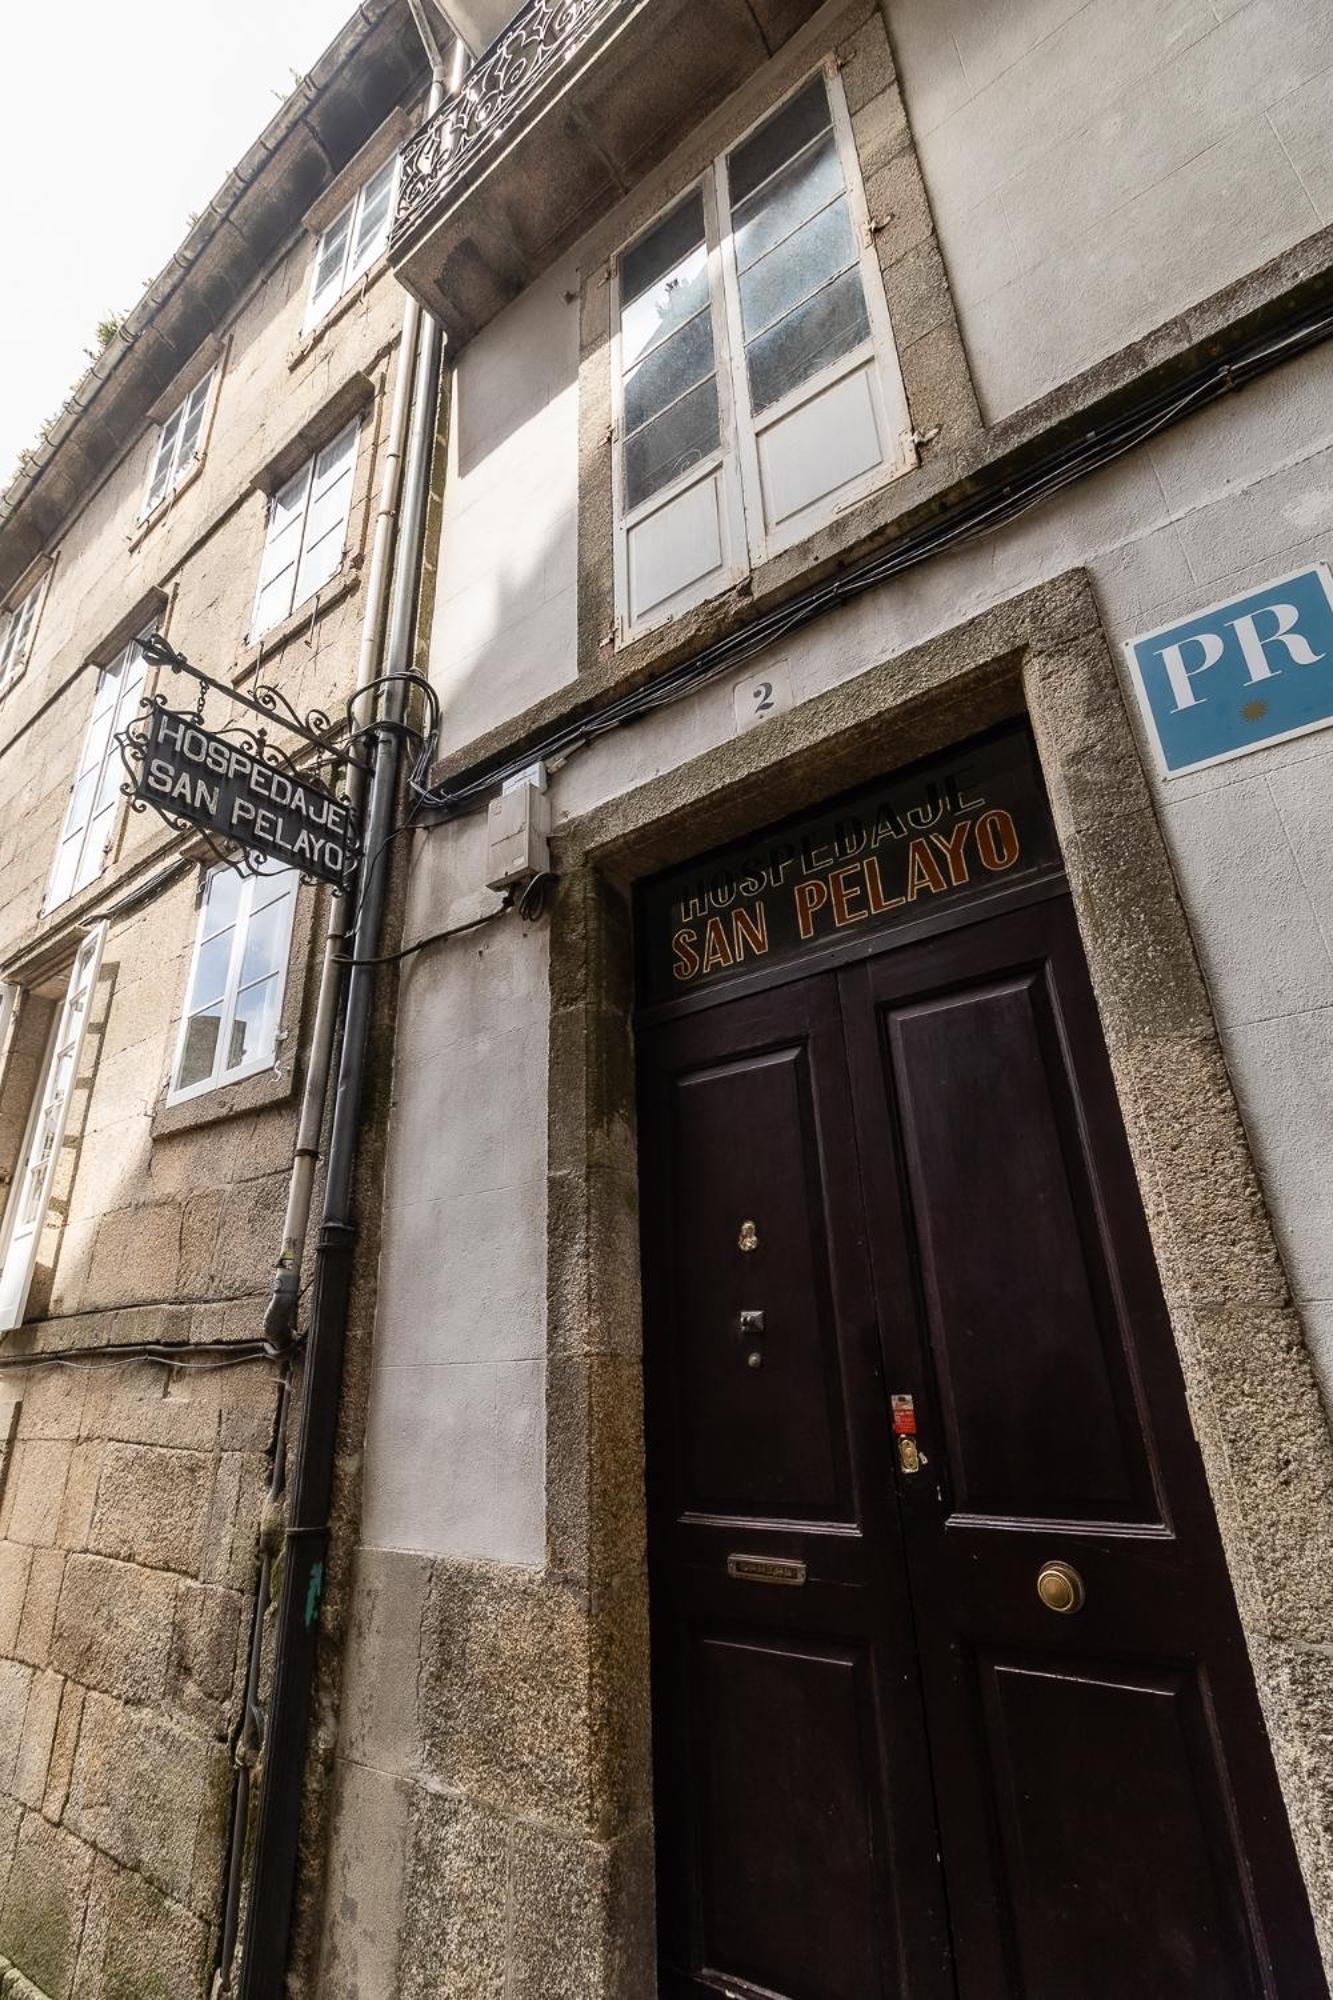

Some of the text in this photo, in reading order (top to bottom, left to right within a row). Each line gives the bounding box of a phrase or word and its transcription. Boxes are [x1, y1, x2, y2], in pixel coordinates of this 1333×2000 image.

[753, 682, 774, 713] 2
[1152, 603, 1327, 714] PR
[148, 758, 344, 871] SAN PELAYO
[157, 715, 346, 834] HOSPEDAJE
[672, 809, 1020, 981] SAN PELAYO
[679, 766, 986, 922] HOSPEDAJE
